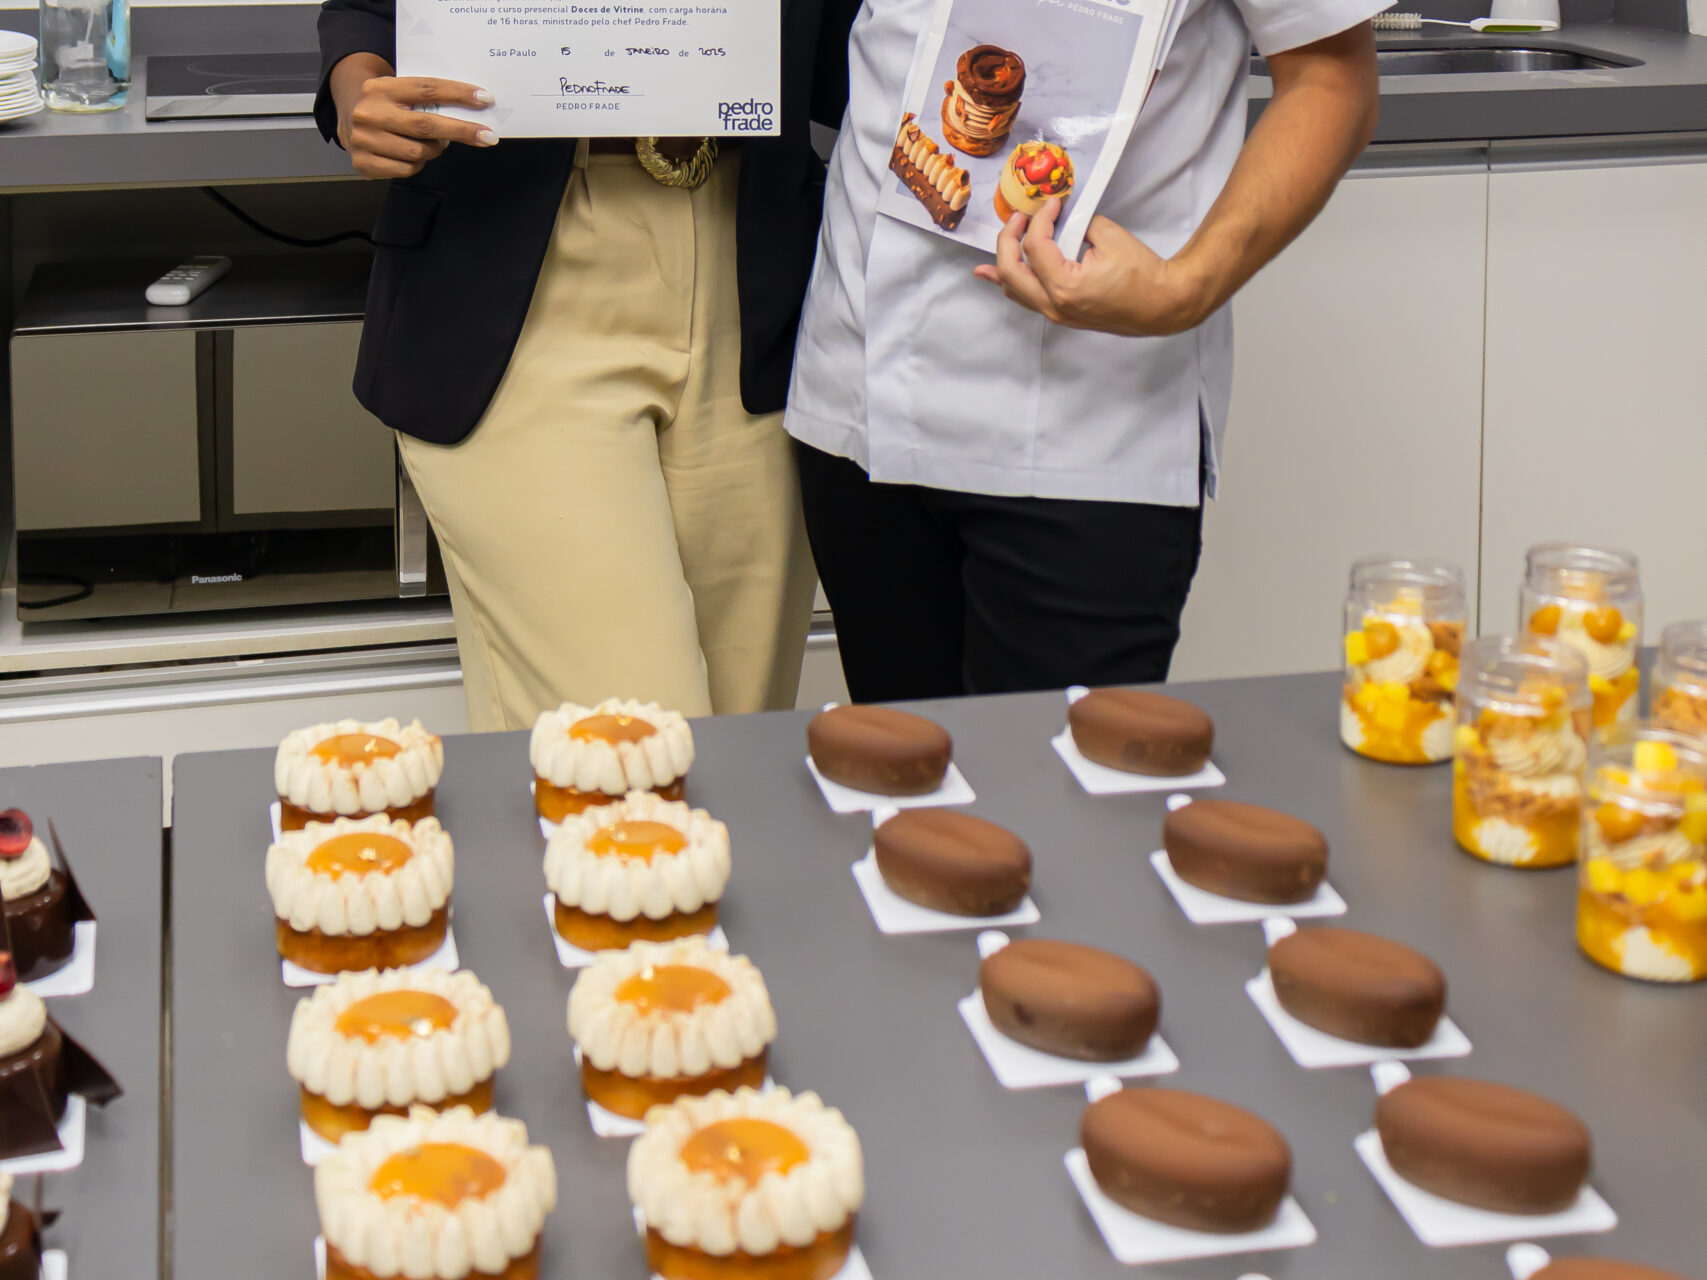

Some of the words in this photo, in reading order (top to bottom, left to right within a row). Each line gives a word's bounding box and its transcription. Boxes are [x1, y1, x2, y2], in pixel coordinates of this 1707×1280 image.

[449, 5, 488, 14] concluiu
[524, 5, 569, 16] presencial
[571, 5, 598, 14] Doces
[600, 5, 611, 14] de
[669, 7, 694, 16] carga
[695, 5, 727, 14] horária
[1068, 3, 1096, 17] PEDRO
[487, 17, 498, 26] de
[500, 17, 511, 26] 16
[542, 17, 589, 26] ministrado
[591, 18, 610, 27] pelo
[612, 17, 632, 26] chef
[634, 17, 660, 26] Pedro
[489, 48, 507, 57] São
[604, 49, 615, 57] de
[678, 49, 690, 57] de
[698, 47, 727, 57] 2025
[556, 102, 587, 111] PEDRO
[589, 102, 621, 111] FRADE
[718, 98, 774, 119] pedro
[722, 113, 773, 131] frade
[191, 573, 243, 584] Panasonic
